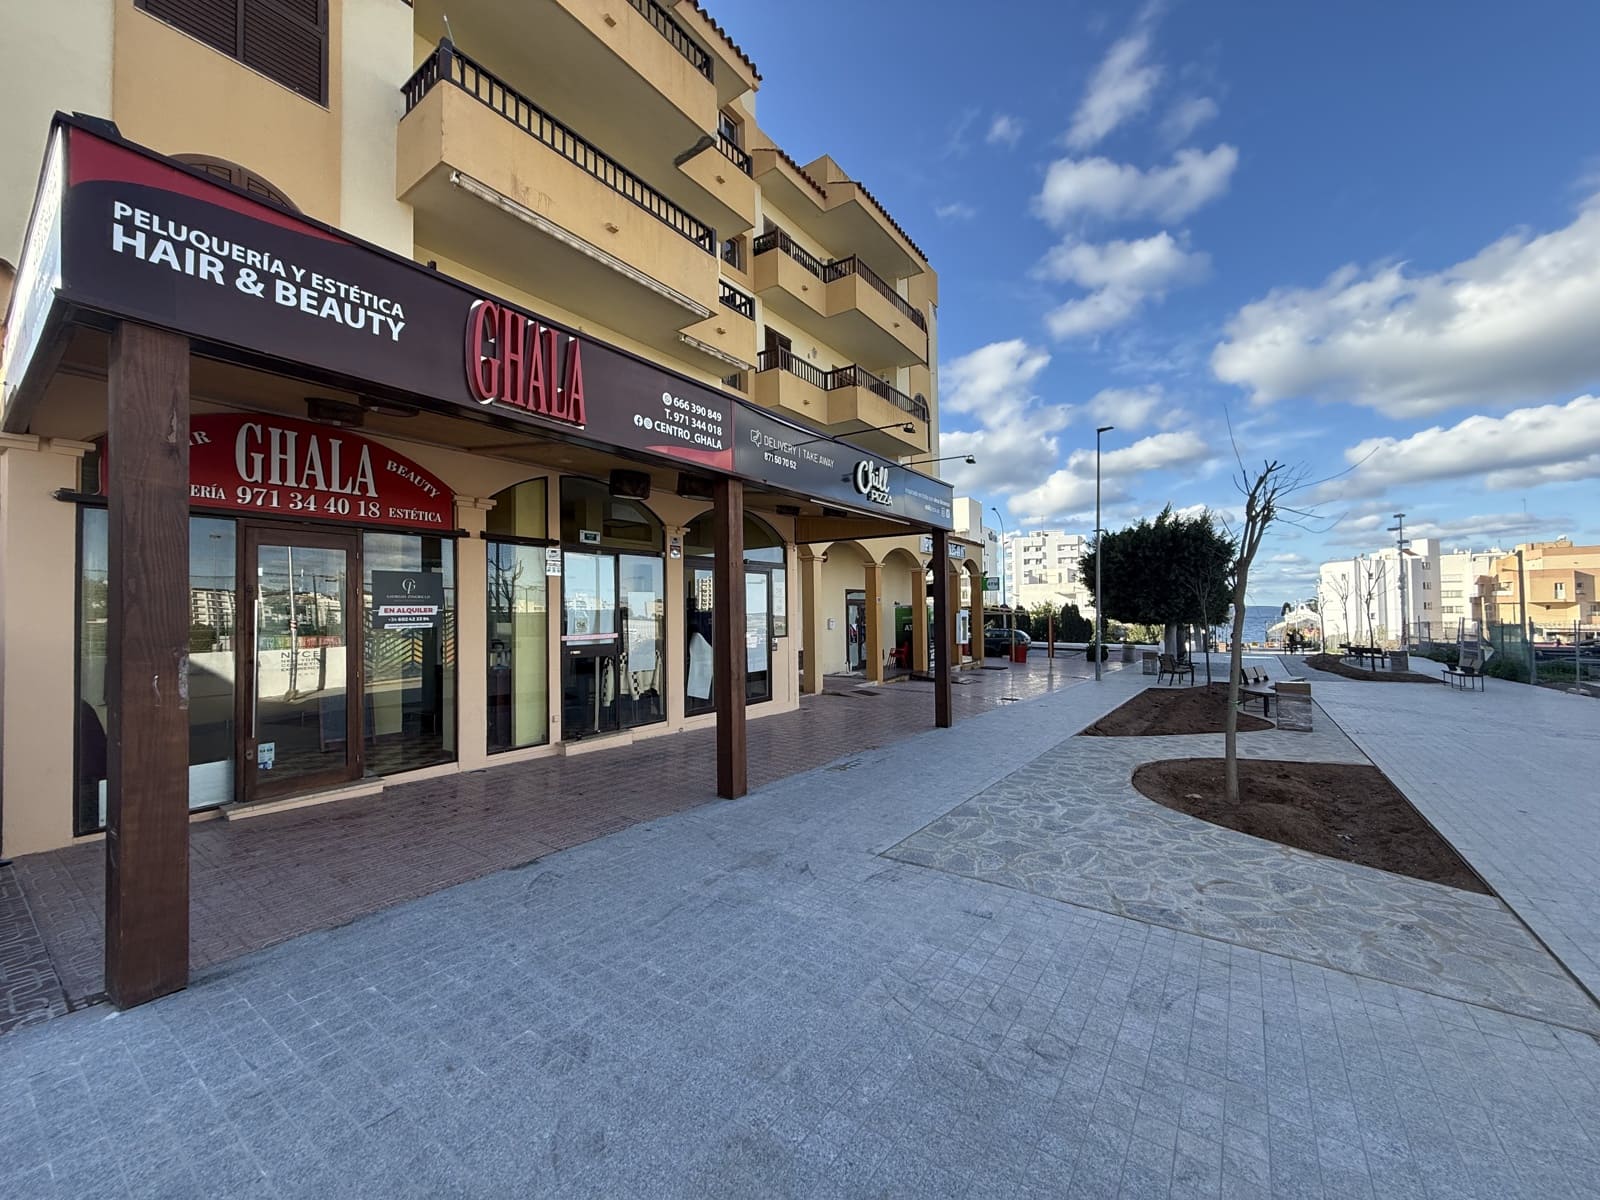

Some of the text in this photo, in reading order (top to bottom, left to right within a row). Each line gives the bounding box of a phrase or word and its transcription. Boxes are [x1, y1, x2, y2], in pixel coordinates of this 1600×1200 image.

[114, 200, 405, 319] PELUQUERÍA Y ESTÉTICA
[112, 223, 405, 342] HAIR & BEAUTY
[467, 299, 586, 428] GHALA
[664, 408, 722, 436] T. 971 344 018
[673, 397, 722, 421] 666 390 849
[654, 420, 722, 450] CENTRO_GHALA
[763, 435, 835, 469] DELIVERY TAKE AWAY
[235, 422, 378, 498] GHALA
[856, 460, 890, 494] Chill
[386, 460, 440, 500] BEAUTY
[871, 489, 893, 506] PIZZA
[236, 486, 280, 508] 971
[289, 492, 317, 511] 34
[324, 497, 350, 515] 40
[358, 501, 381, 518] 18
[389, 507, 442, 523] ESTÉTICA
